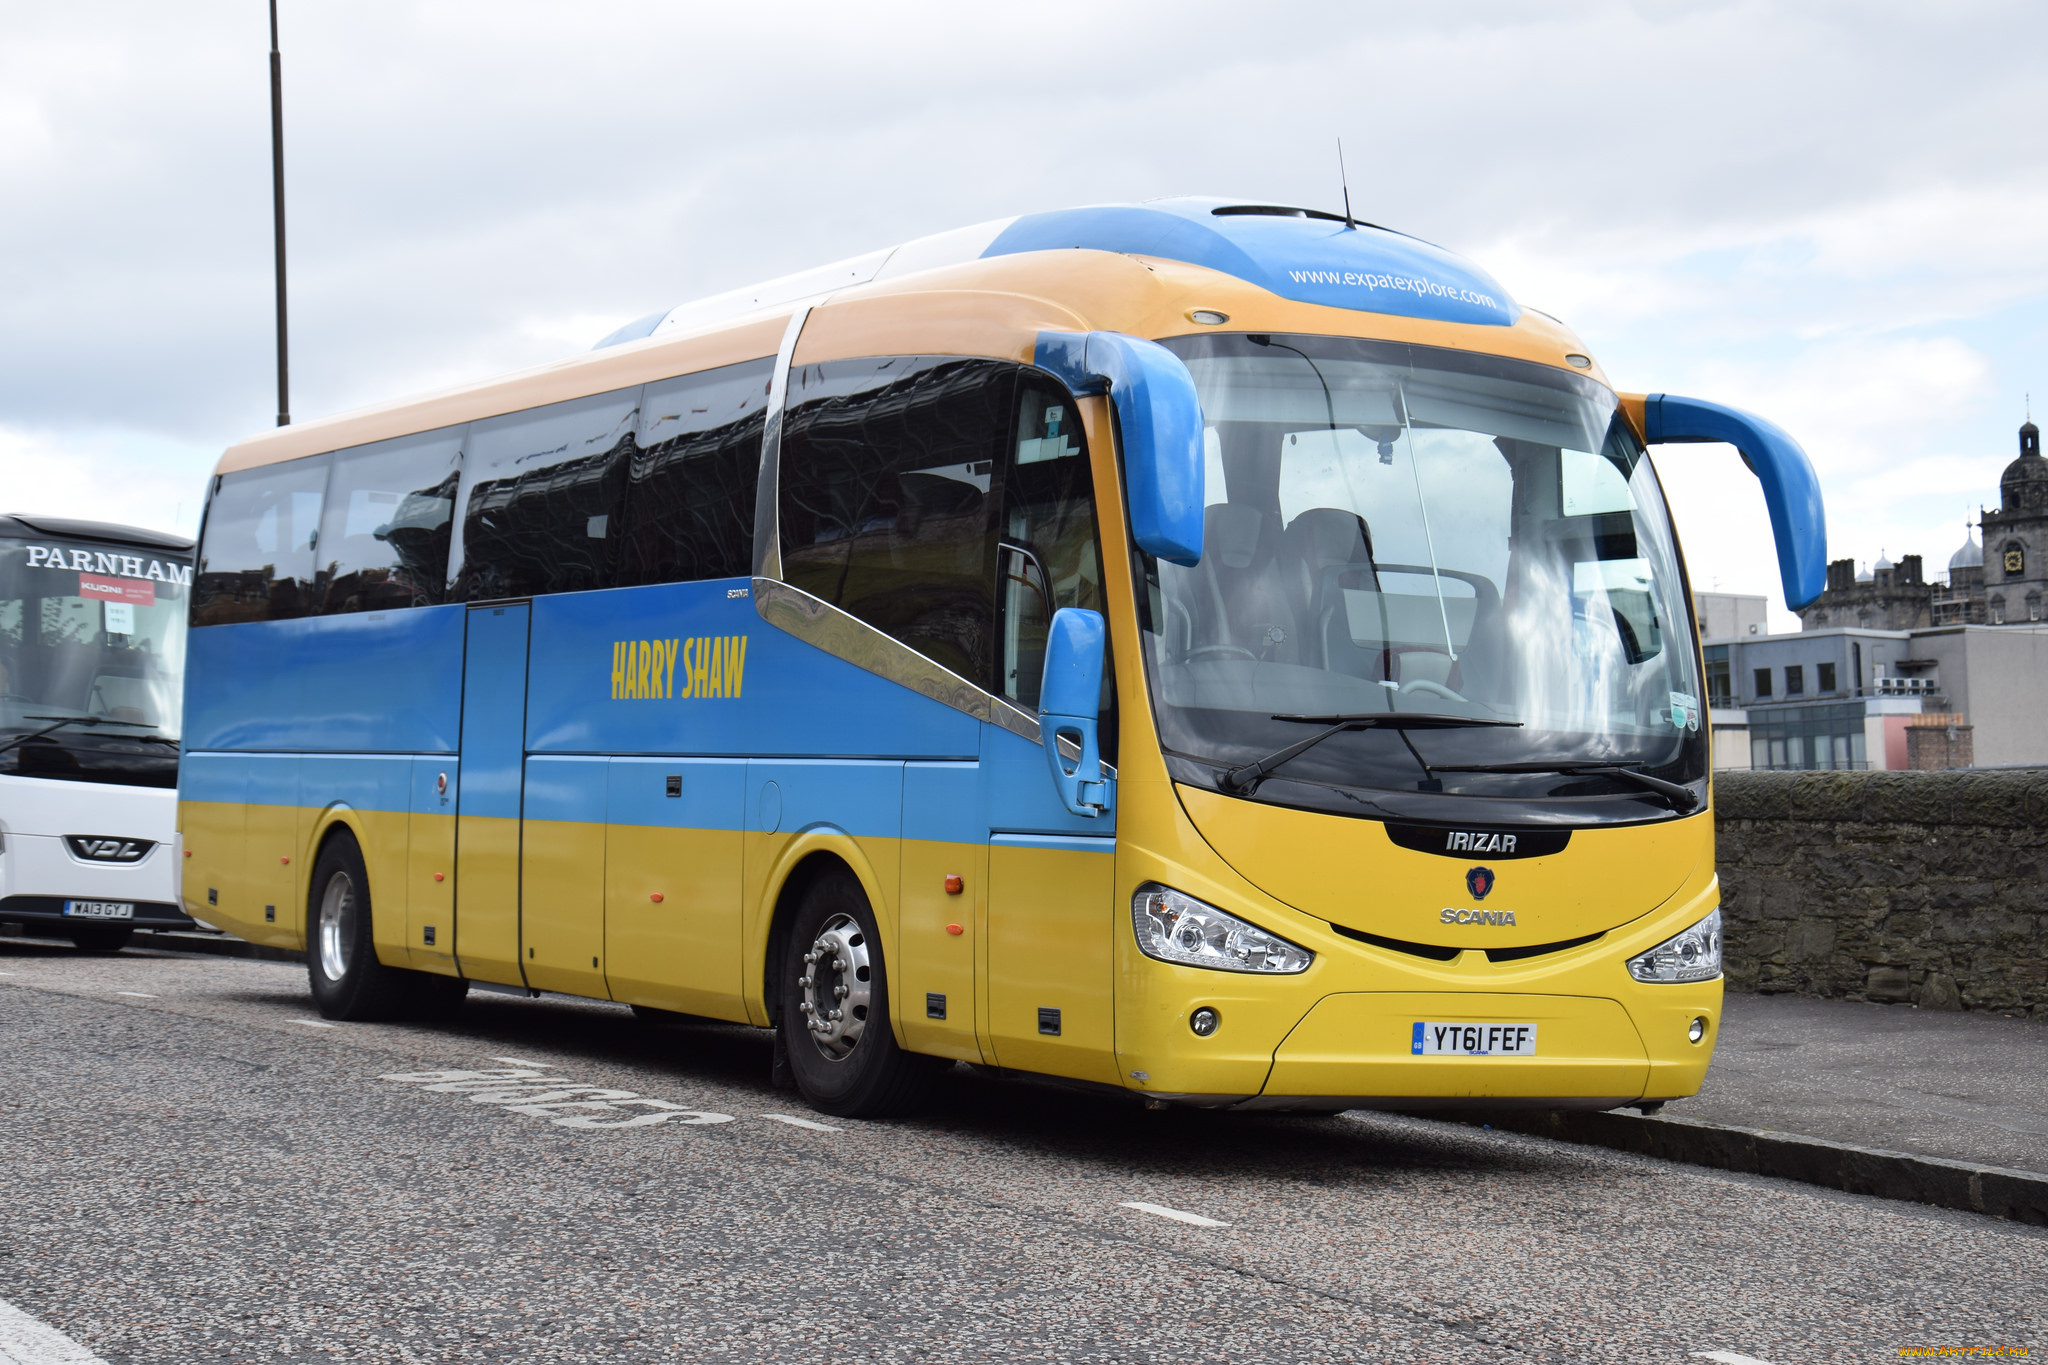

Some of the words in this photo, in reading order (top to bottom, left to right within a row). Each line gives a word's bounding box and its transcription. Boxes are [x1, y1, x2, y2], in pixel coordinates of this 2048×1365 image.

[1289, 270, 1497, 309] www.expatexplore.com
[26, 545, 192, 587] PARNHAM
[81, 581, 122, 594] KUONI
[727, 589, 748, 599] SCANIA
[611, 638, 679, 699] HARRY
[681, 635, 747, 699] SHAW
[77, 839, 141, 858] VDL
[1446, 832, 1517, 853] IRIZAR
[104, 904, 128, 916] GYJ
[1440, 908, 1517, 927] SCANIA
[1434, 1026, 1483, 1051] YT61
[1488, 1027, 1529, 1051] FEF
[377, 1069, 735, 1129] BUSES
